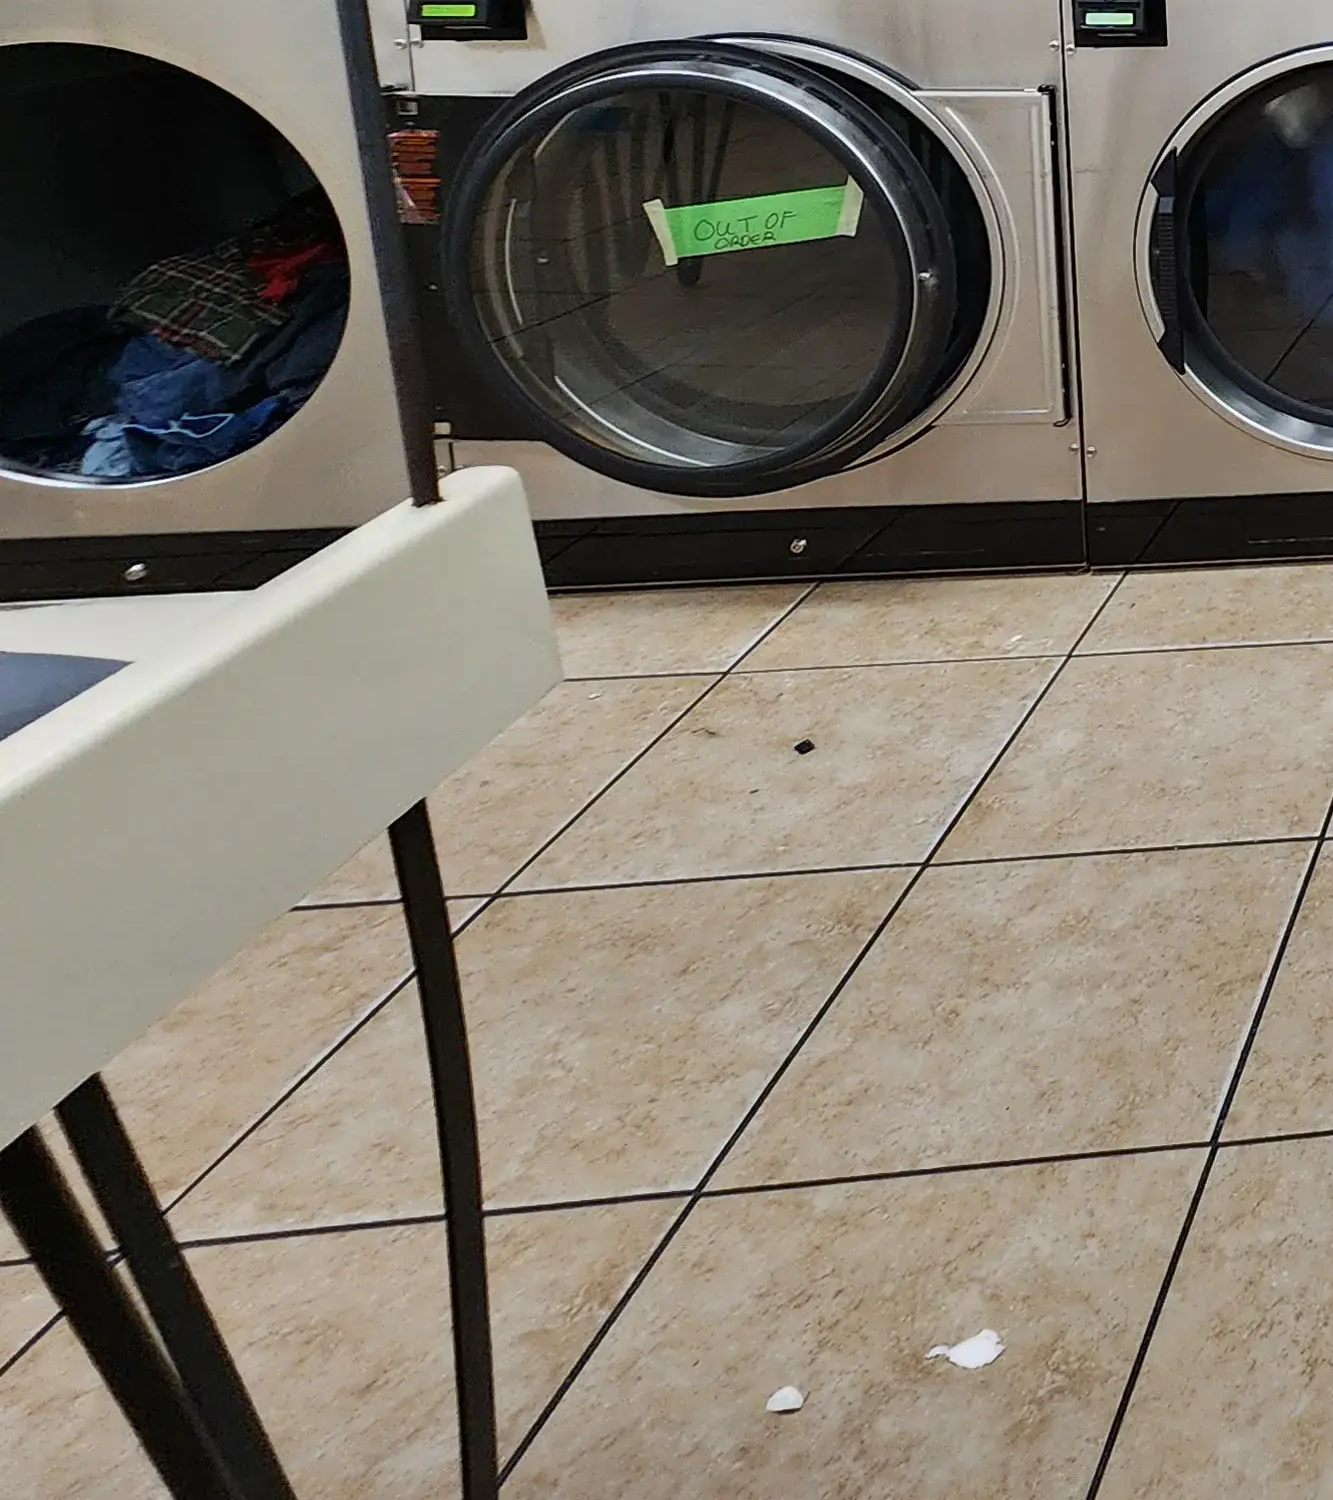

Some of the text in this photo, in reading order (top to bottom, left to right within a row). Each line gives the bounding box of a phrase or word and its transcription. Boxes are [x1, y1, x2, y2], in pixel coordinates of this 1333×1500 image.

[694, 211, 798, 241] OUT OF
[715, 232, 776, 250] ORDER
